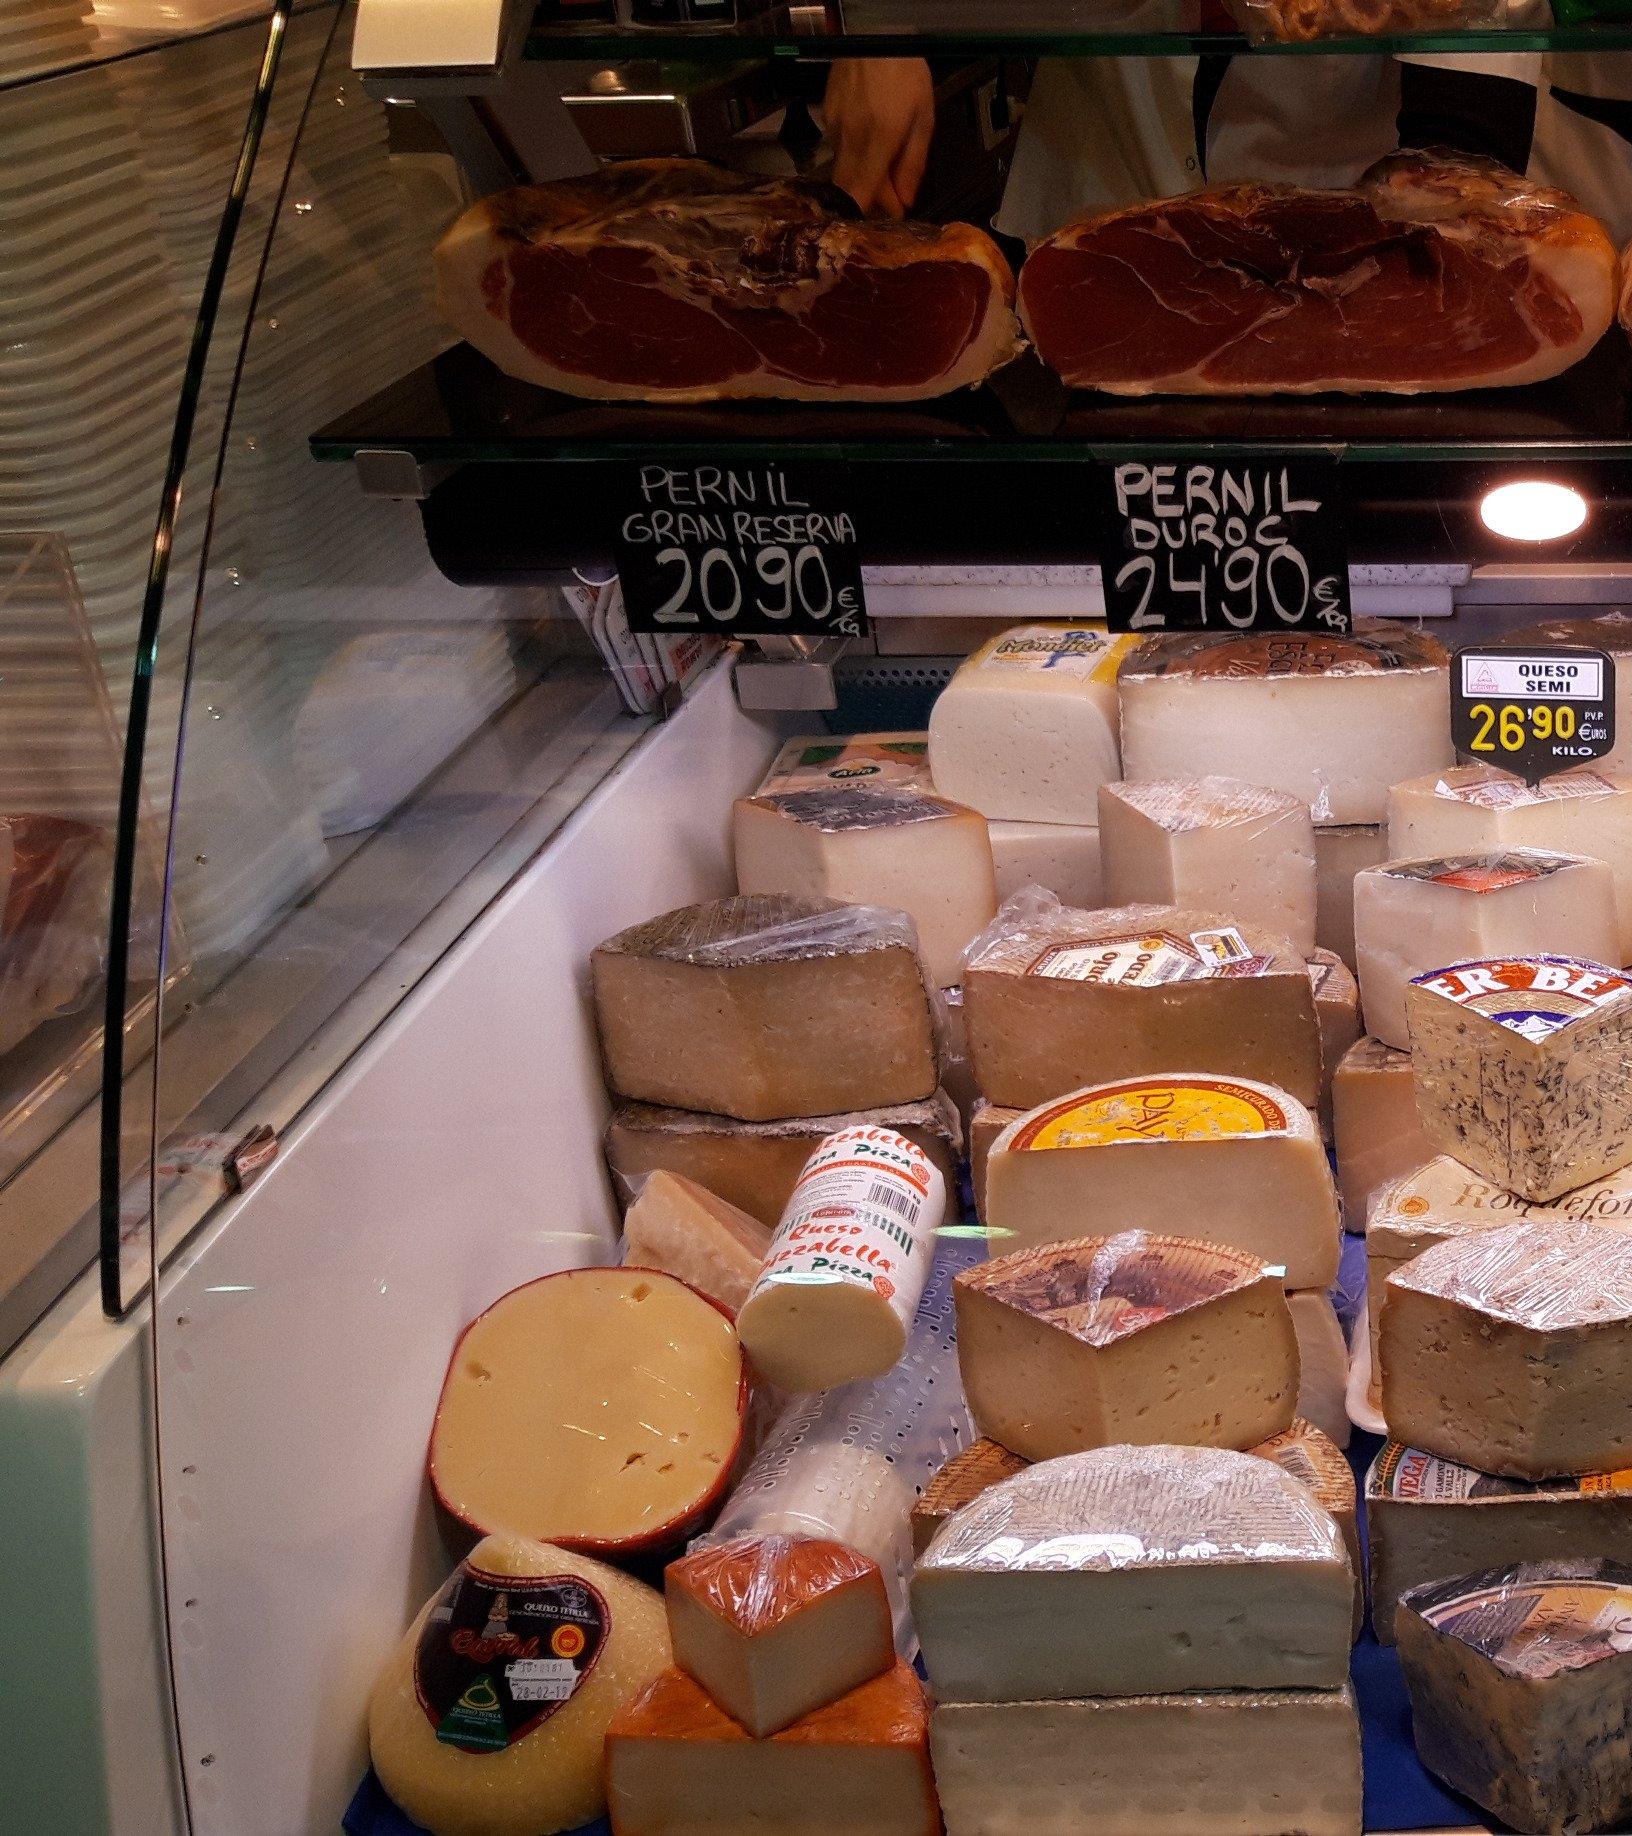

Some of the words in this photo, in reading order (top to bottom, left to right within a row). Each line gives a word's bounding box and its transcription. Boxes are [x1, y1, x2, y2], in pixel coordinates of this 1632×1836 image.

[640, 462, 810, 508] PERNIL
[1115, 463, 1322, 517] PERNIL
[622, 509, 729, 544] GRAN
[733, 511, 856, 545] RESERVA
[1131, 513, 1289, 550] DUROC
[653, 545, 833, 624] 20'90
[1115, 544, 1310, 629] 24'90
[1518, 664, 1578, 678] QUESO
[1526, 680, 1571, 693] SEMI
[1469, 703, 1575, 751] 26'90
[1552, 746, 1597, 756] KILO.
[789, 1222, 863, 1242] Queso
[1399, 1456, 1429, 1498] VEGA
